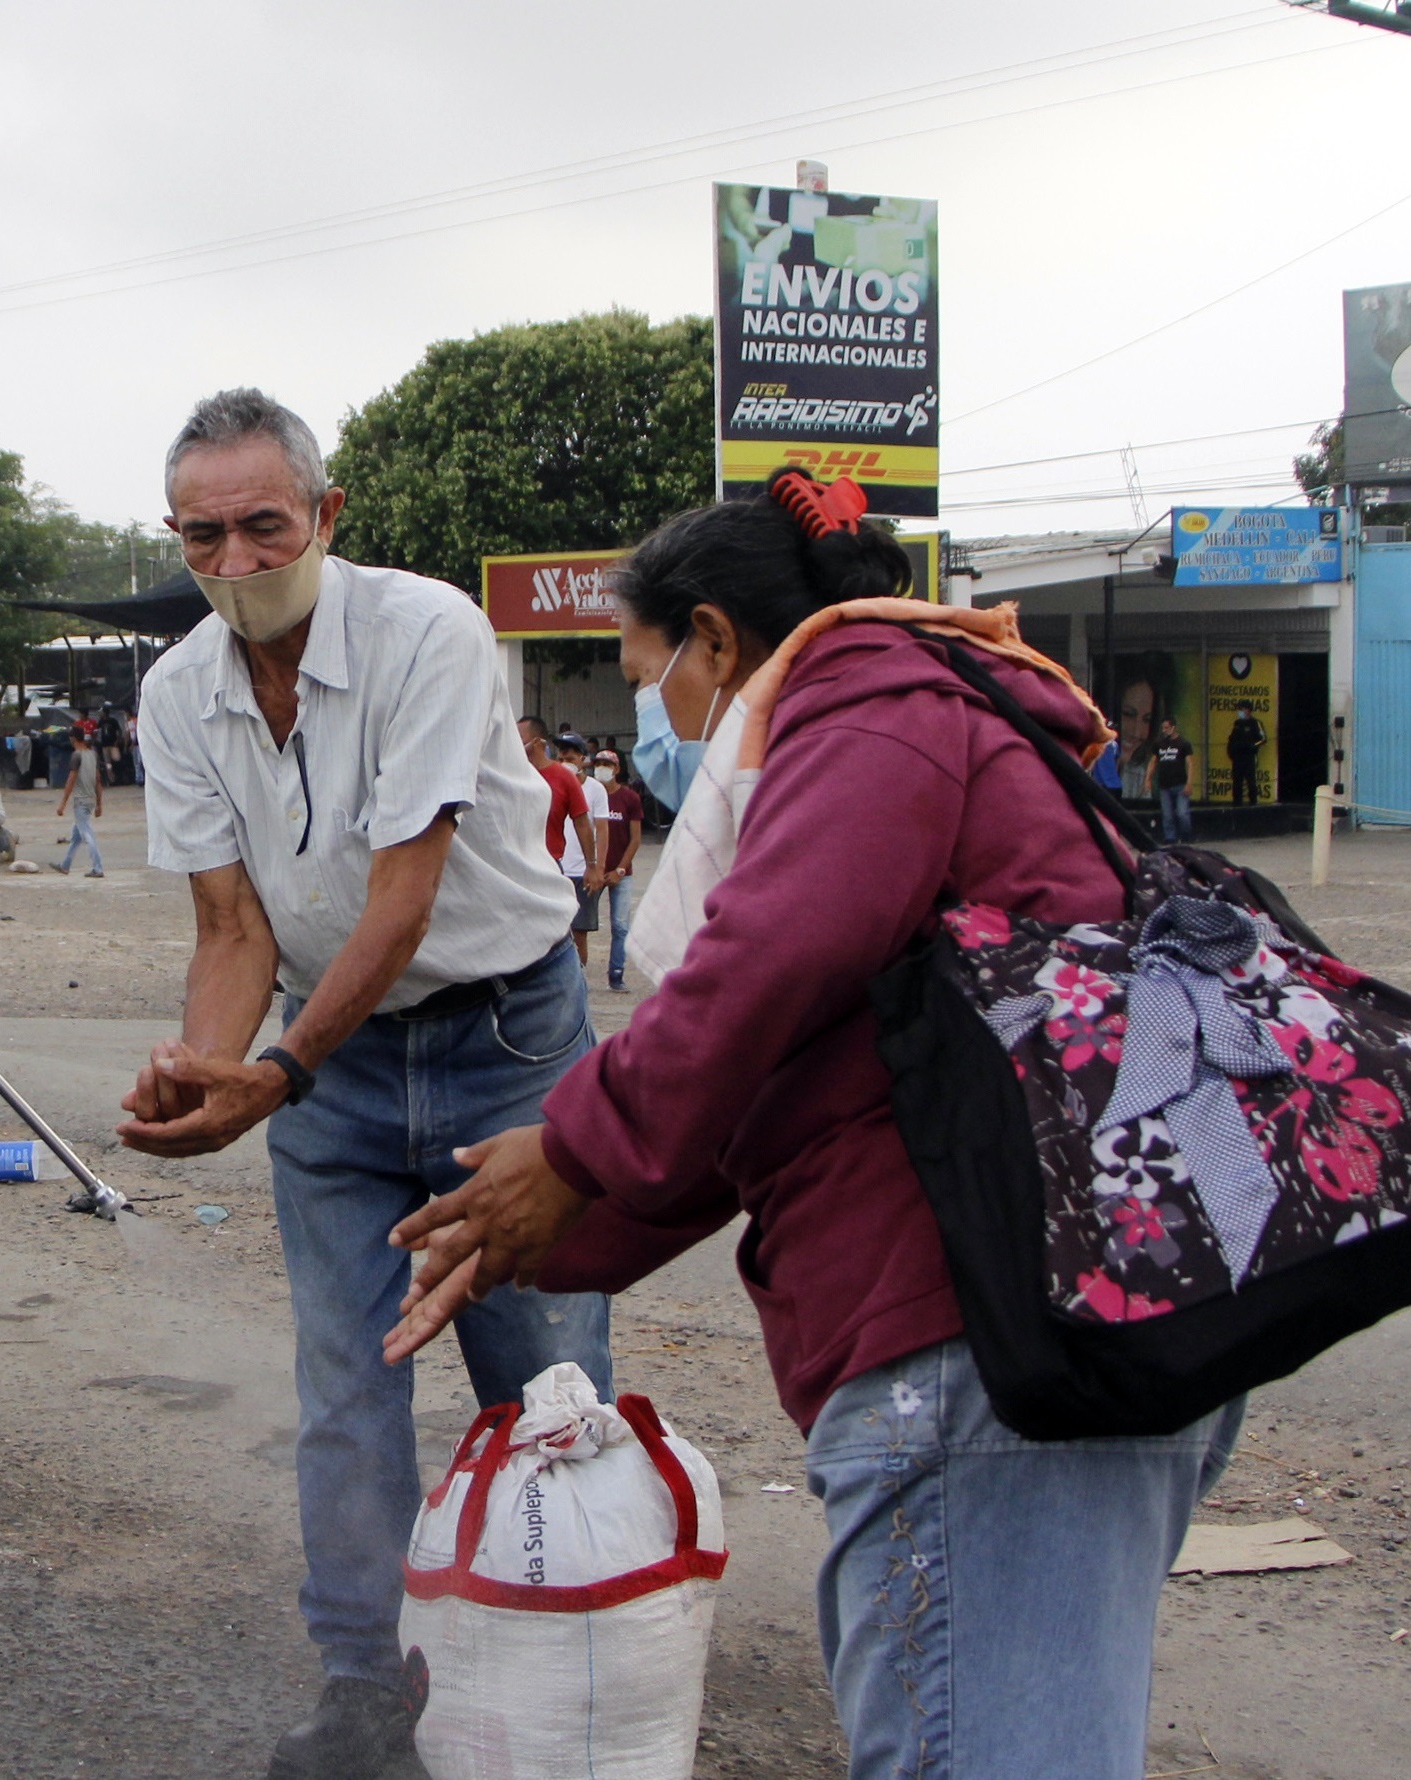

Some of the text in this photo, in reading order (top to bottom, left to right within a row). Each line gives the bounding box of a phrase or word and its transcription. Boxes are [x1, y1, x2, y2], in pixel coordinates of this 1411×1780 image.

[742, 310, 927, 343] NACIONALES E
[741, 341, 927, 369] INTERNACIONALES
[743, 383, 788, 397] INTER
[783, 449, 888, 478] DHL
[1203, 530, 1271, 547] MEDELLIN
[1286, 529, 1316, 545] CALI
[1253, 550, 1300, 565] ECUADOR
[1311, 547, 1337, 563] PERU
[1264, 564, 1320, 580] ARGENTINA
[1209, 685, 1269, 697] CONECTAMOS
[1209, 698, 1270, 713] PERSAS
